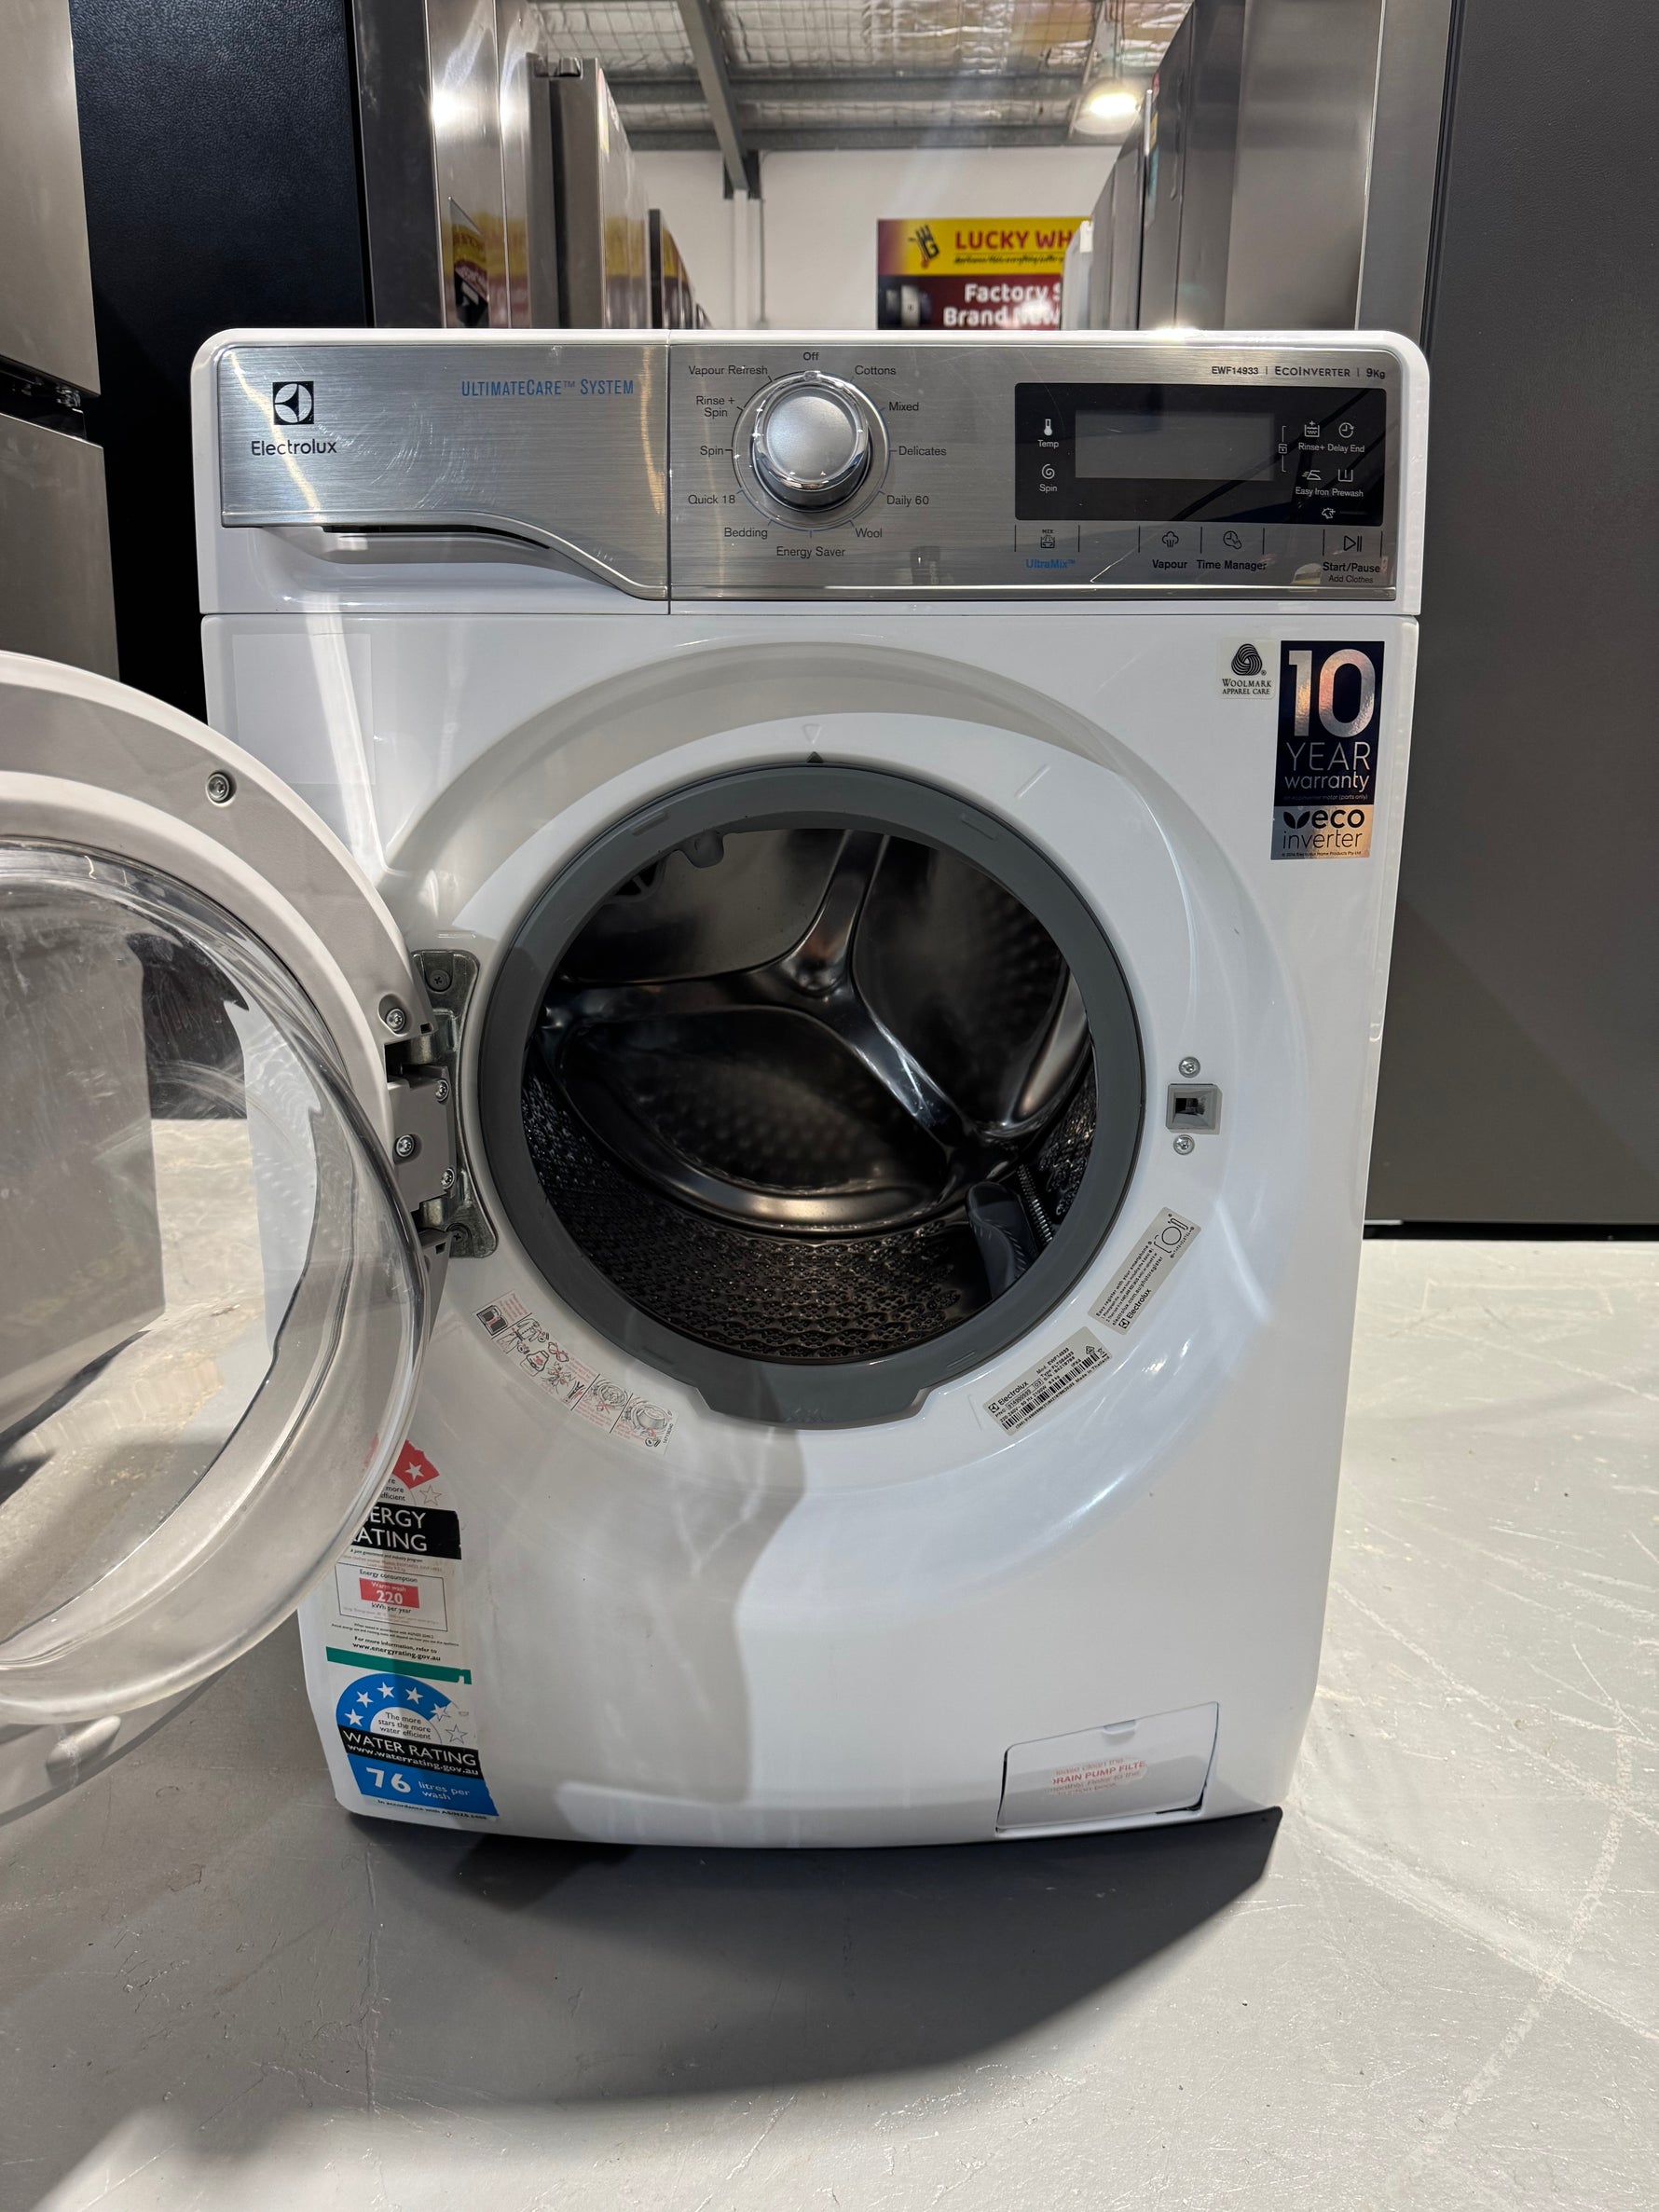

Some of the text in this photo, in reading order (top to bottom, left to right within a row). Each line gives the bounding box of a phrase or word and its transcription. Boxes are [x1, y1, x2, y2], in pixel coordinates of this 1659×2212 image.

[955, 230, 1029, 249] LUCKY
[965, 283, 1048, 303] Factory
[943, 307, 1008, 325] Brand
[802, 352, 819, 361] Off
[689, 365, 768, 377] Vapour Refresh
[855, 365, 897, 376] Cottons
[1212, 366, 1258, 375] EWF14933
[696, 396, 725, 405] Rinse
[889, 402, 919, 411] Mixed
[705, 407, 728, 419] Spin
[252, 439, 337, 457] Electrolux
[1037, 440, 1059, 448] Temp
[1328, 444, 1348, 454] Delay
[700, 446, 723, 457] Spin
[898, 446, 947, 456] Delicates
[1039, 484, 1058, 493] Spin
[1296, 487, 1329, 497] Easy Iron
[1332, 488, 1364, 497] Prewash
[688, 494, 735, 504] Quick 18
[886, 495, 929, 507] Daily 60
[724, 528, 768, 539] Bedding
[856, 528, 883, 538] Wool
[776, 546, 845, 558] Energy Saver
[1152, 560, 1187, 570] Vapour
[1197, 560, 1267, 571] Time Manager
[1323, 562, 1380, 572] Start/Pause
[1346, 575, 1374, 584] Clothes
[1288, 649, 1376, 737] 10
[1286, 742, 1370, 771] YEAR
[1284, 771, 1369, 792] warranty
[1311, 809, 1364, 829] eco
[1282, 830, 1363, 849] inverter
[1125, 1286, 1152, 1319] Electrolux
[996, 1379, 1029, 1406] Electrolux
[370, 1506, 426, 1529] ERGY
[356, 1527, 427, 1551] ATING
[360, 1569, 418, 1583] Energy consumption
[371, 1581, 390, 1589] Warm
[377, 1590, 403, 1604] 220
[353, 1642, 440, 1661] www.energyrating.gov.au
[385, 1712, 400, 1721] The
[380, 1726, 431, 1739] water efficient
[343, 1730, 476, 1765] WATER RATING
[348, 1744, 478, 1776] www.waterrating.gov.au
[1085, 1766, 1116, 1779] PUMP
[1119, 1761, 1145, 1771] FILTE
[366, 1767, 411, 1793] 76
[418, 1781, 447, 1792] litres
[422, 1791, 451, 1800] wash
